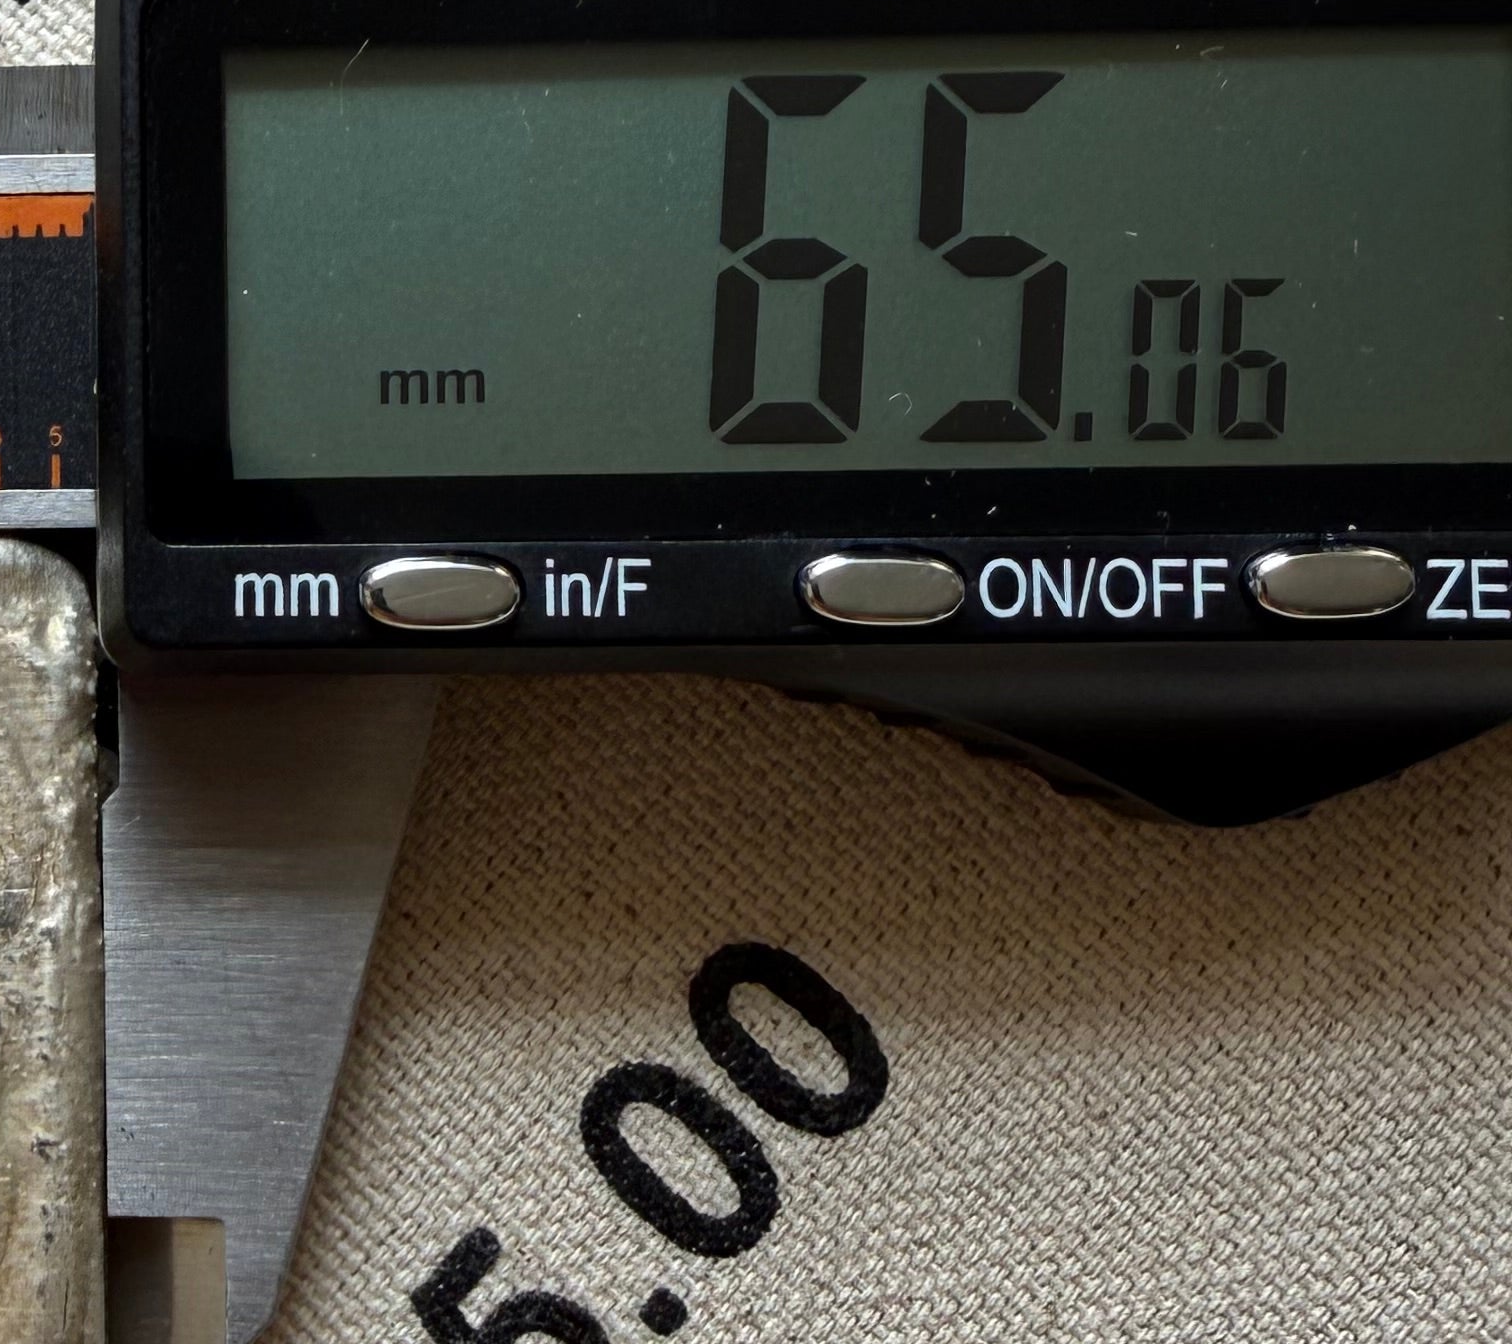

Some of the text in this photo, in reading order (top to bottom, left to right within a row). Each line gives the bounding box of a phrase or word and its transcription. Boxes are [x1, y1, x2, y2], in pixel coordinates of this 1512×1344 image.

[710, 73, 1286, 445] 65.06
[379, 368, 486, 405] mm
[50, 427, 62, 446] 5
[233, 571, 339, 618] mm
[544, 556, 653, 618] in/F
[978, 557, 1229, 620] ON/OFF
